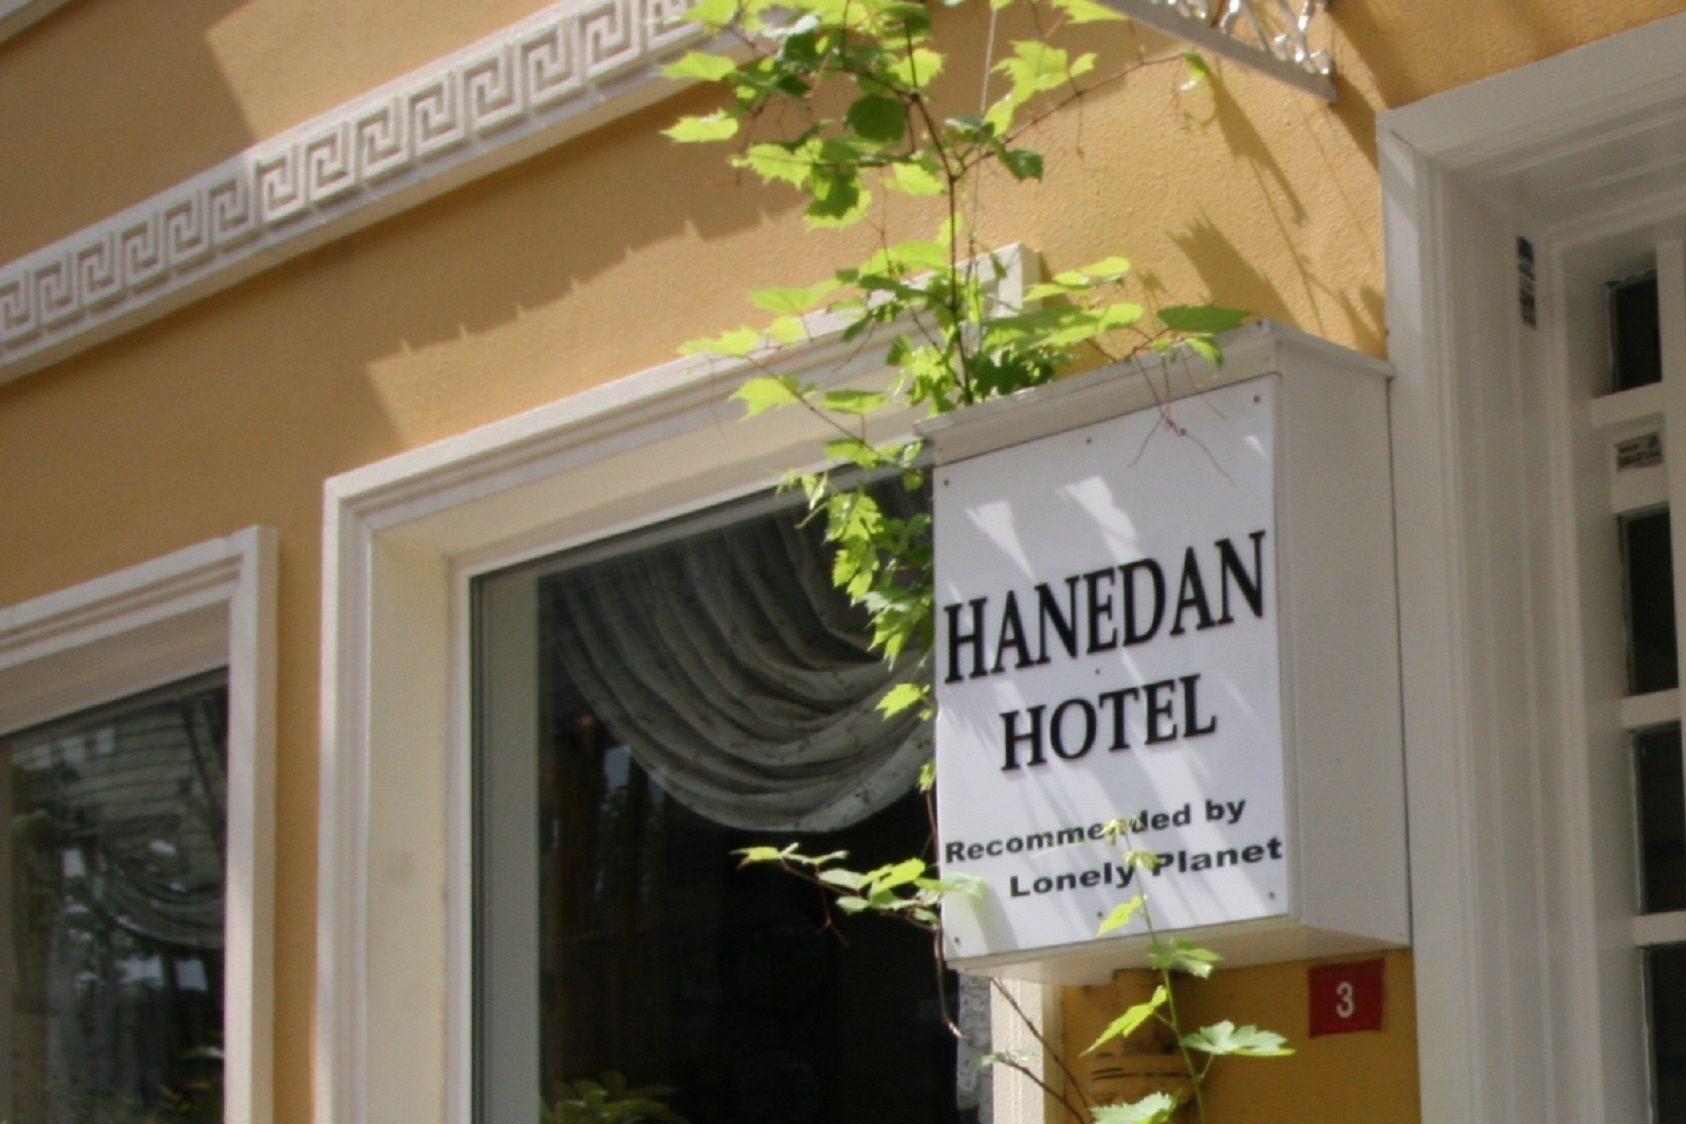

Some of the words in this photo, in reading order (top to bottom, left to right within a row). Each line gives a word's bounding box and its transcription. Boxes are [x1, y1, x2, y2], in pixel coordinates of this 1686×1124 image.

[943, 529, 1267, 685] HANEDAN
[999, 673, 1217, 771] HOTEL
[945, 804, 1191, 864] Recommeded
[1206, 799, 1246, 825] by
[1010, 861, 1135, 897] Lonely
[1151, 837, 1283, 877] Planet
[1336, 981, 1354, 1018] 3
